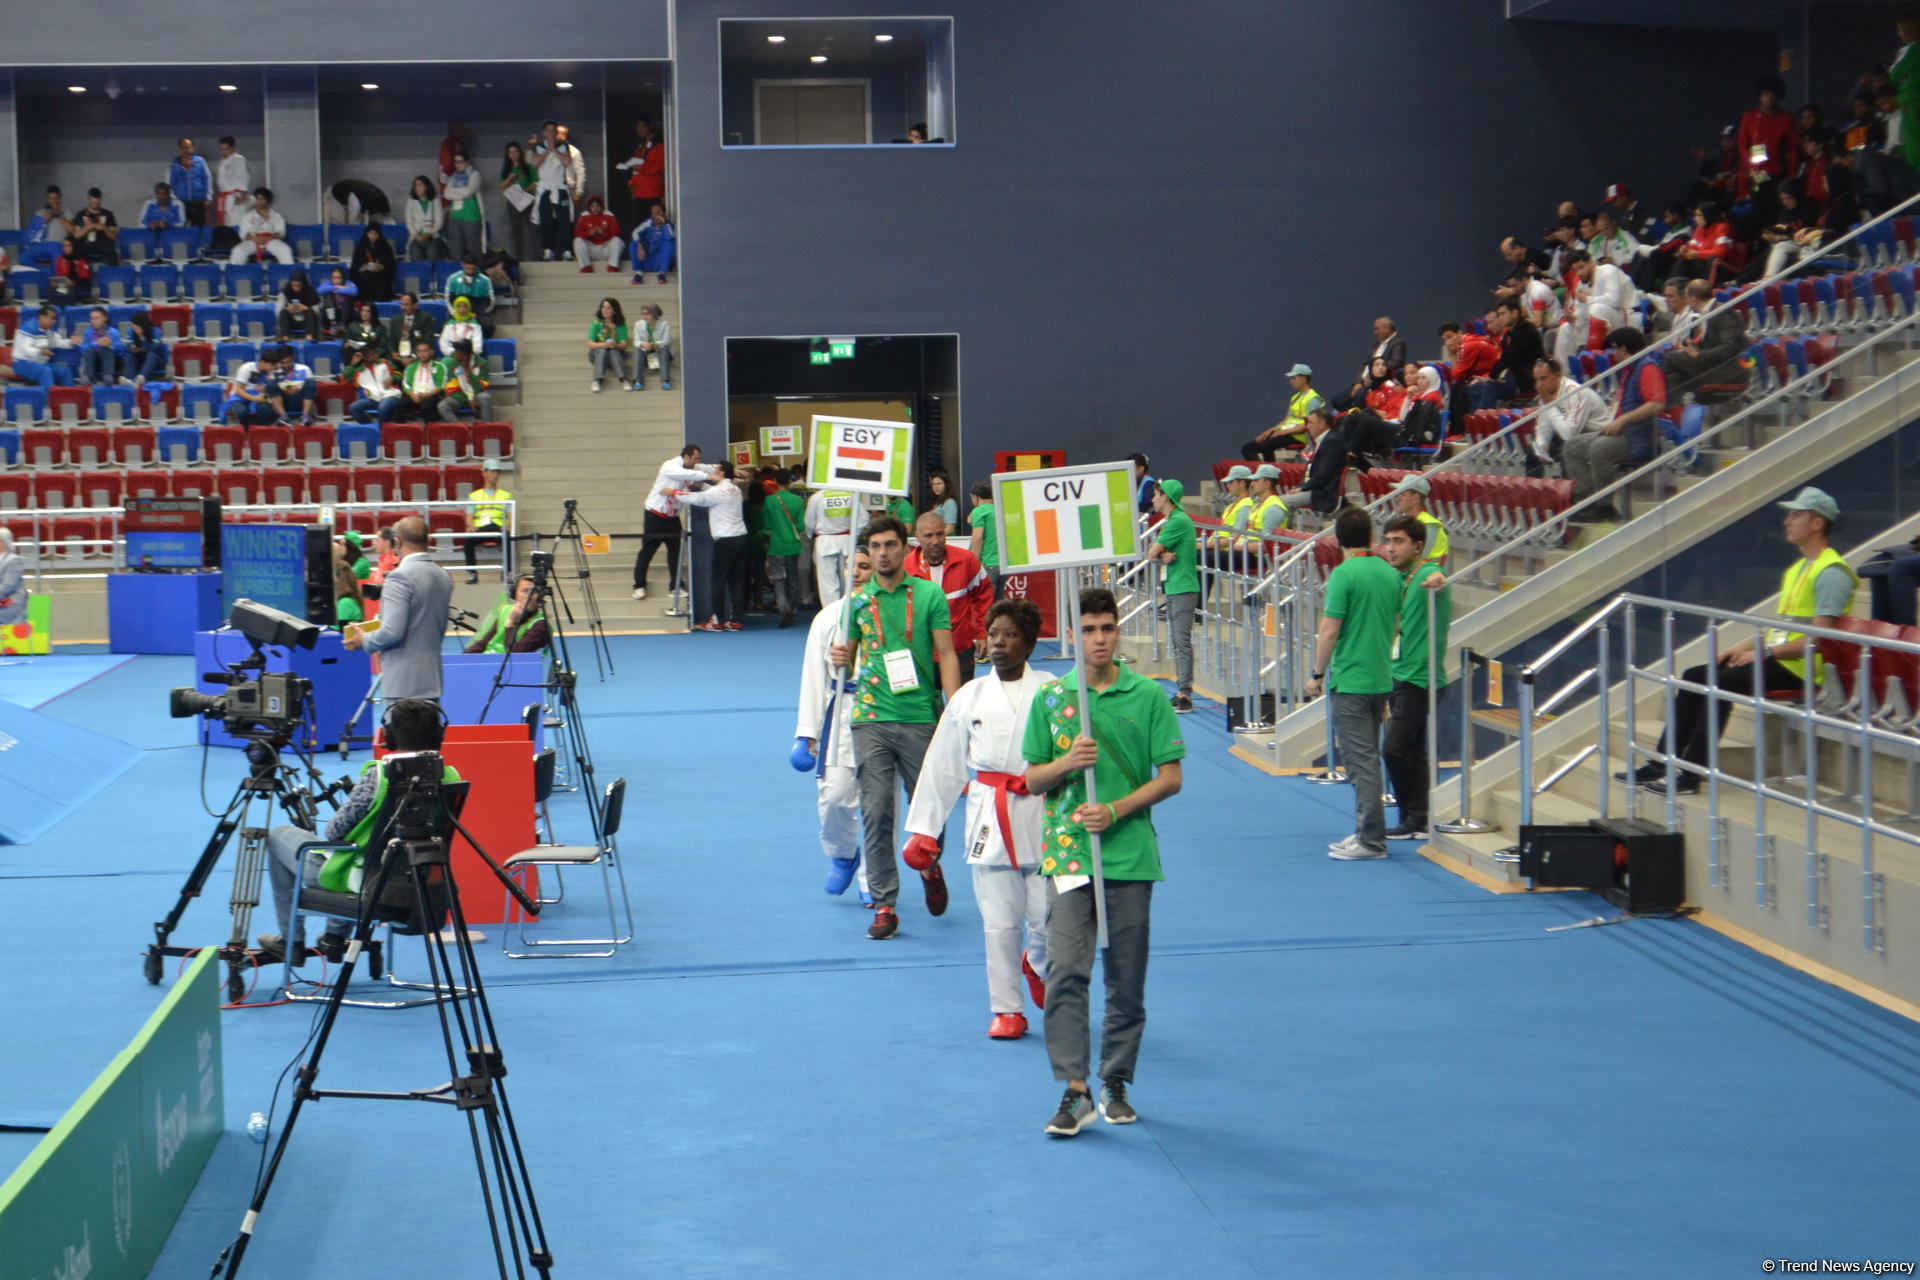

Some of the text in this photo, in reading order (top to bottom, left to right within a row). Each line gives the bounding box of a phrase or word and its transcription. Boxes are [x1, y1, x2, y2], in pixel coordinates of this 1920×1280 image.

[843, 428, 881, 444] EGY
[1044, 480, 1085, 502] CIV
[826, 497, 849, 507] EGY
[223, 529, 300, 559] WINNER
[271, 698, 278, 710] 3
